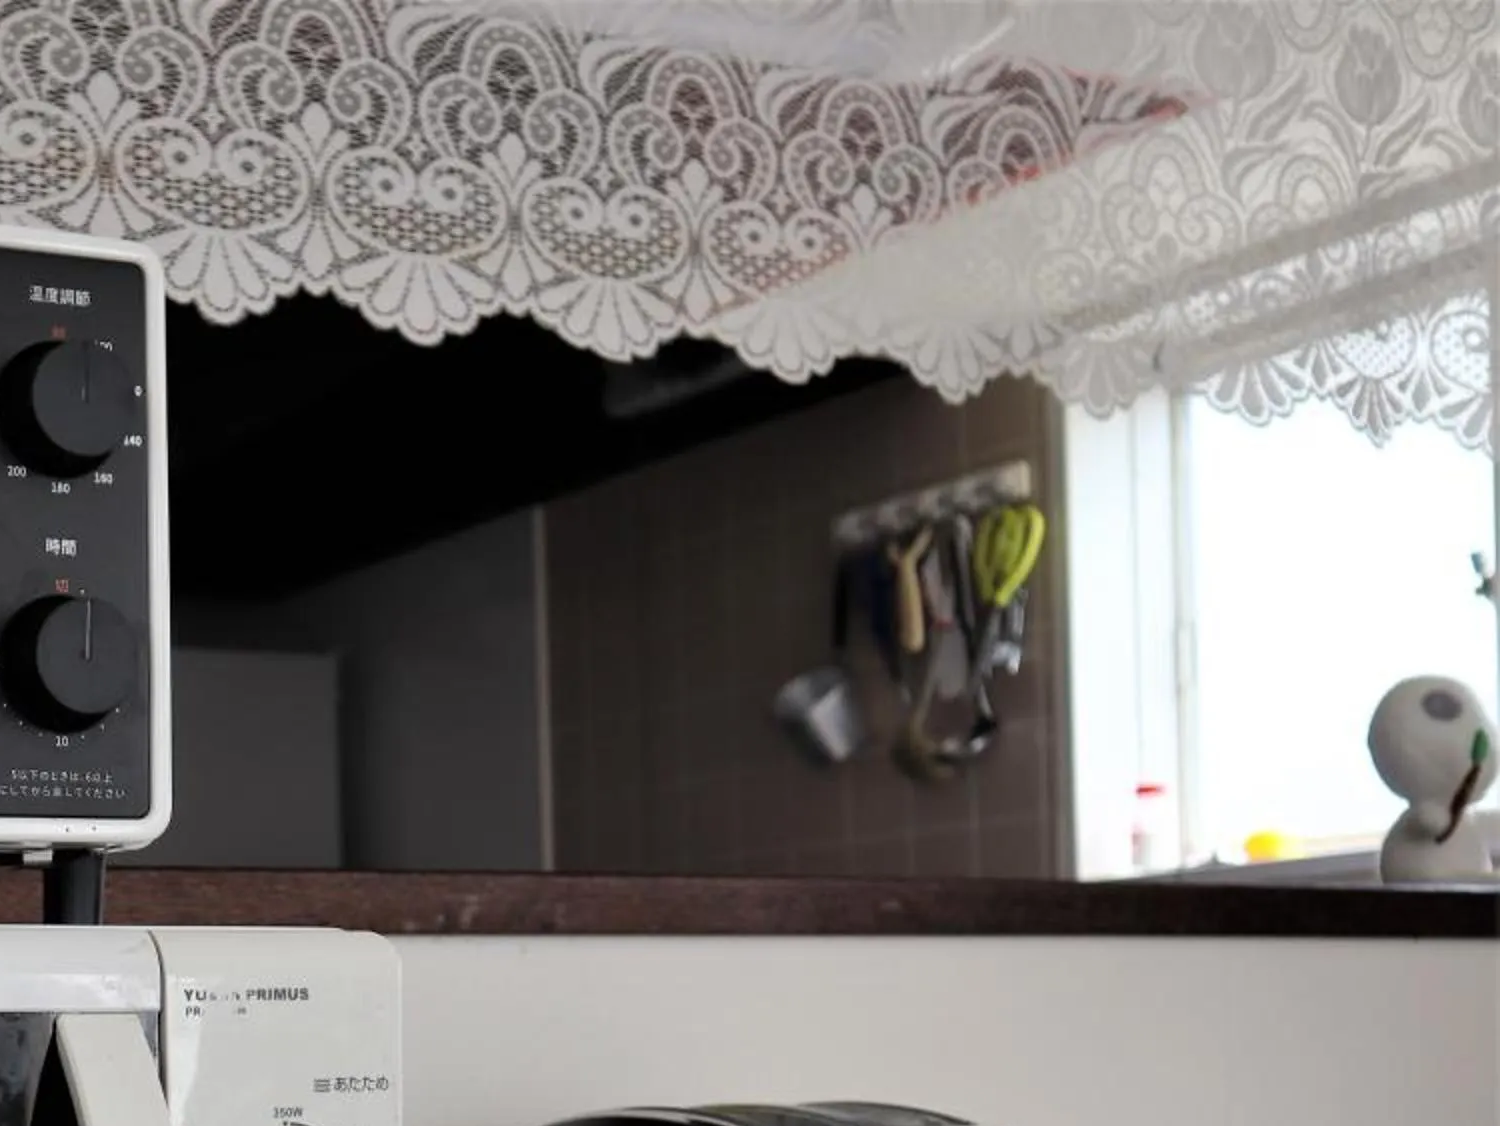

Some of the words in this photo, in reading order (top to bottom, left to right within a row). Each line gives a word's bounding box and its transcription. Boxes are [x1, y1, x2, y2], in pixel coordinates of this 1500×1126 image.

[45, 538, 77, 556] 時間
[55, 735, 69, 747] 10
[246, 987, 310, 1001] PRIMUS
